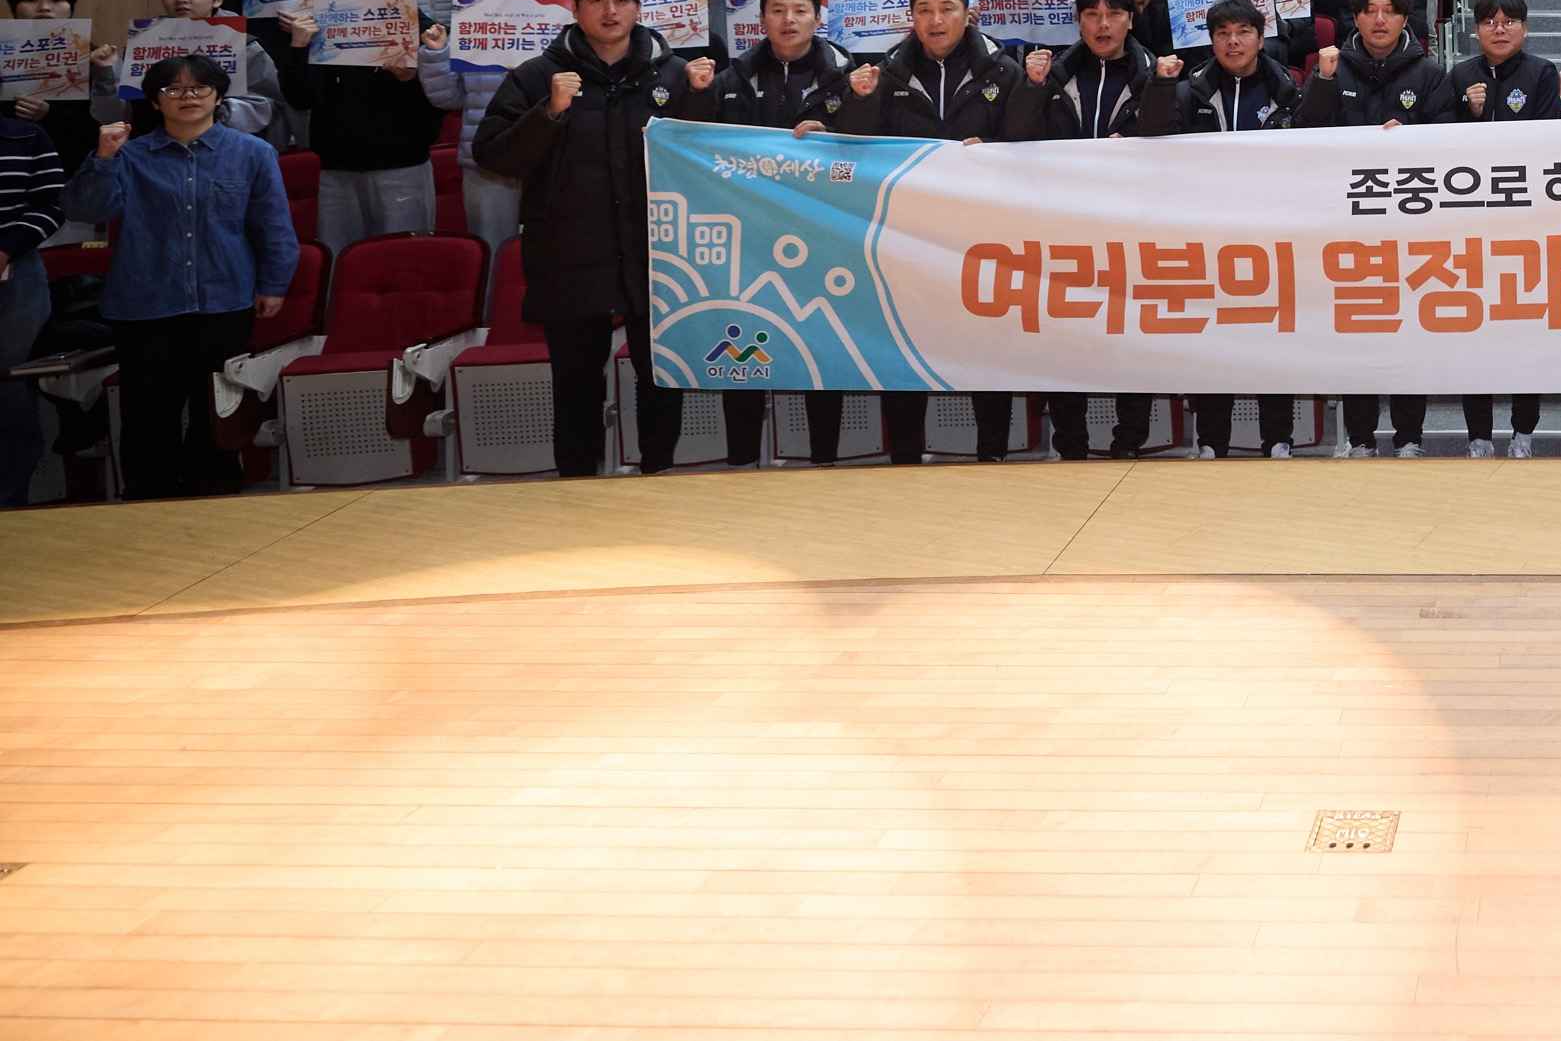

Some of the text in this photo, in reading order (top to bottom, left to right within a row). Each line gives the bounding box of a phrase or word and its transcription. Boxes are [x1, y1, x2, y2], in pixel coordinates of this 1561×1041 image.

[362, 6, 402, 21] 스포츠
[669, 3, 699, 19] 인권
[833, 1, 878, 13] 함께하는
[843, 15, 867, 28] 함께
[868, 14, 901, 25] 지키는
[980, 12, 1074, 26] 함께 지키는 인권
[326, 20, 411, 39] 함께 지키는 인권
[458, 21, 517, 36] 함께하는
[733, 22, 768, 36] 함께하
[20, 37, 67, 53] 스포츠
[458, 37, 489, 51] 함께
[492, 37, 535, 51] 지키는
[3, 51, 79, 72] 지키는 인권
[1346, 163, 1534, 216] 존중으로
[960, 240, 1296, 336] 여러분의
[706, 365, 771, 383] 아산시
